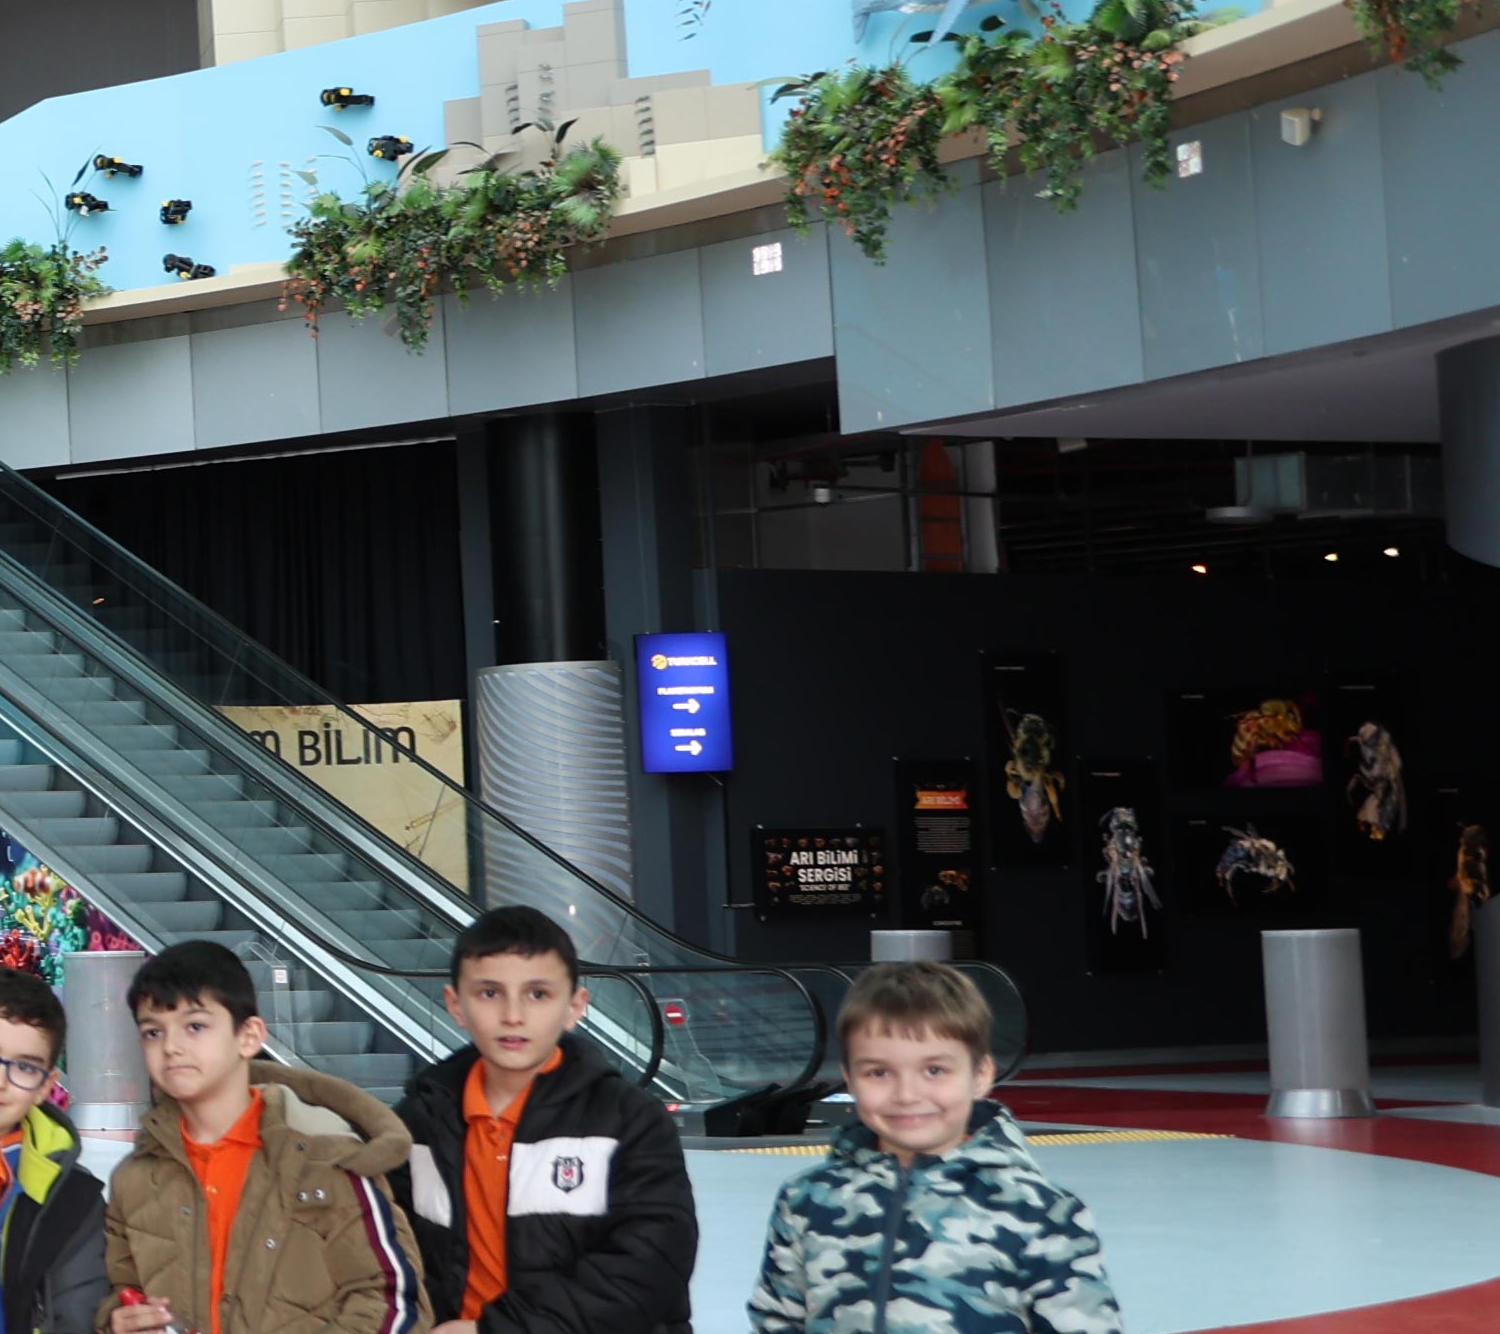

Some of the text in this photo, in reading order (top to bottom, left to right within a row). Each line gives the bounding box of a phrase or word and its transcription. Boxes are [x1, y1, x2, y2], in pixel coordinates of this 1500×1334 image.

[790, 850, 858, 865] ARI BİLİMİ
[797, 867, 852, 883] SERGİSİ
